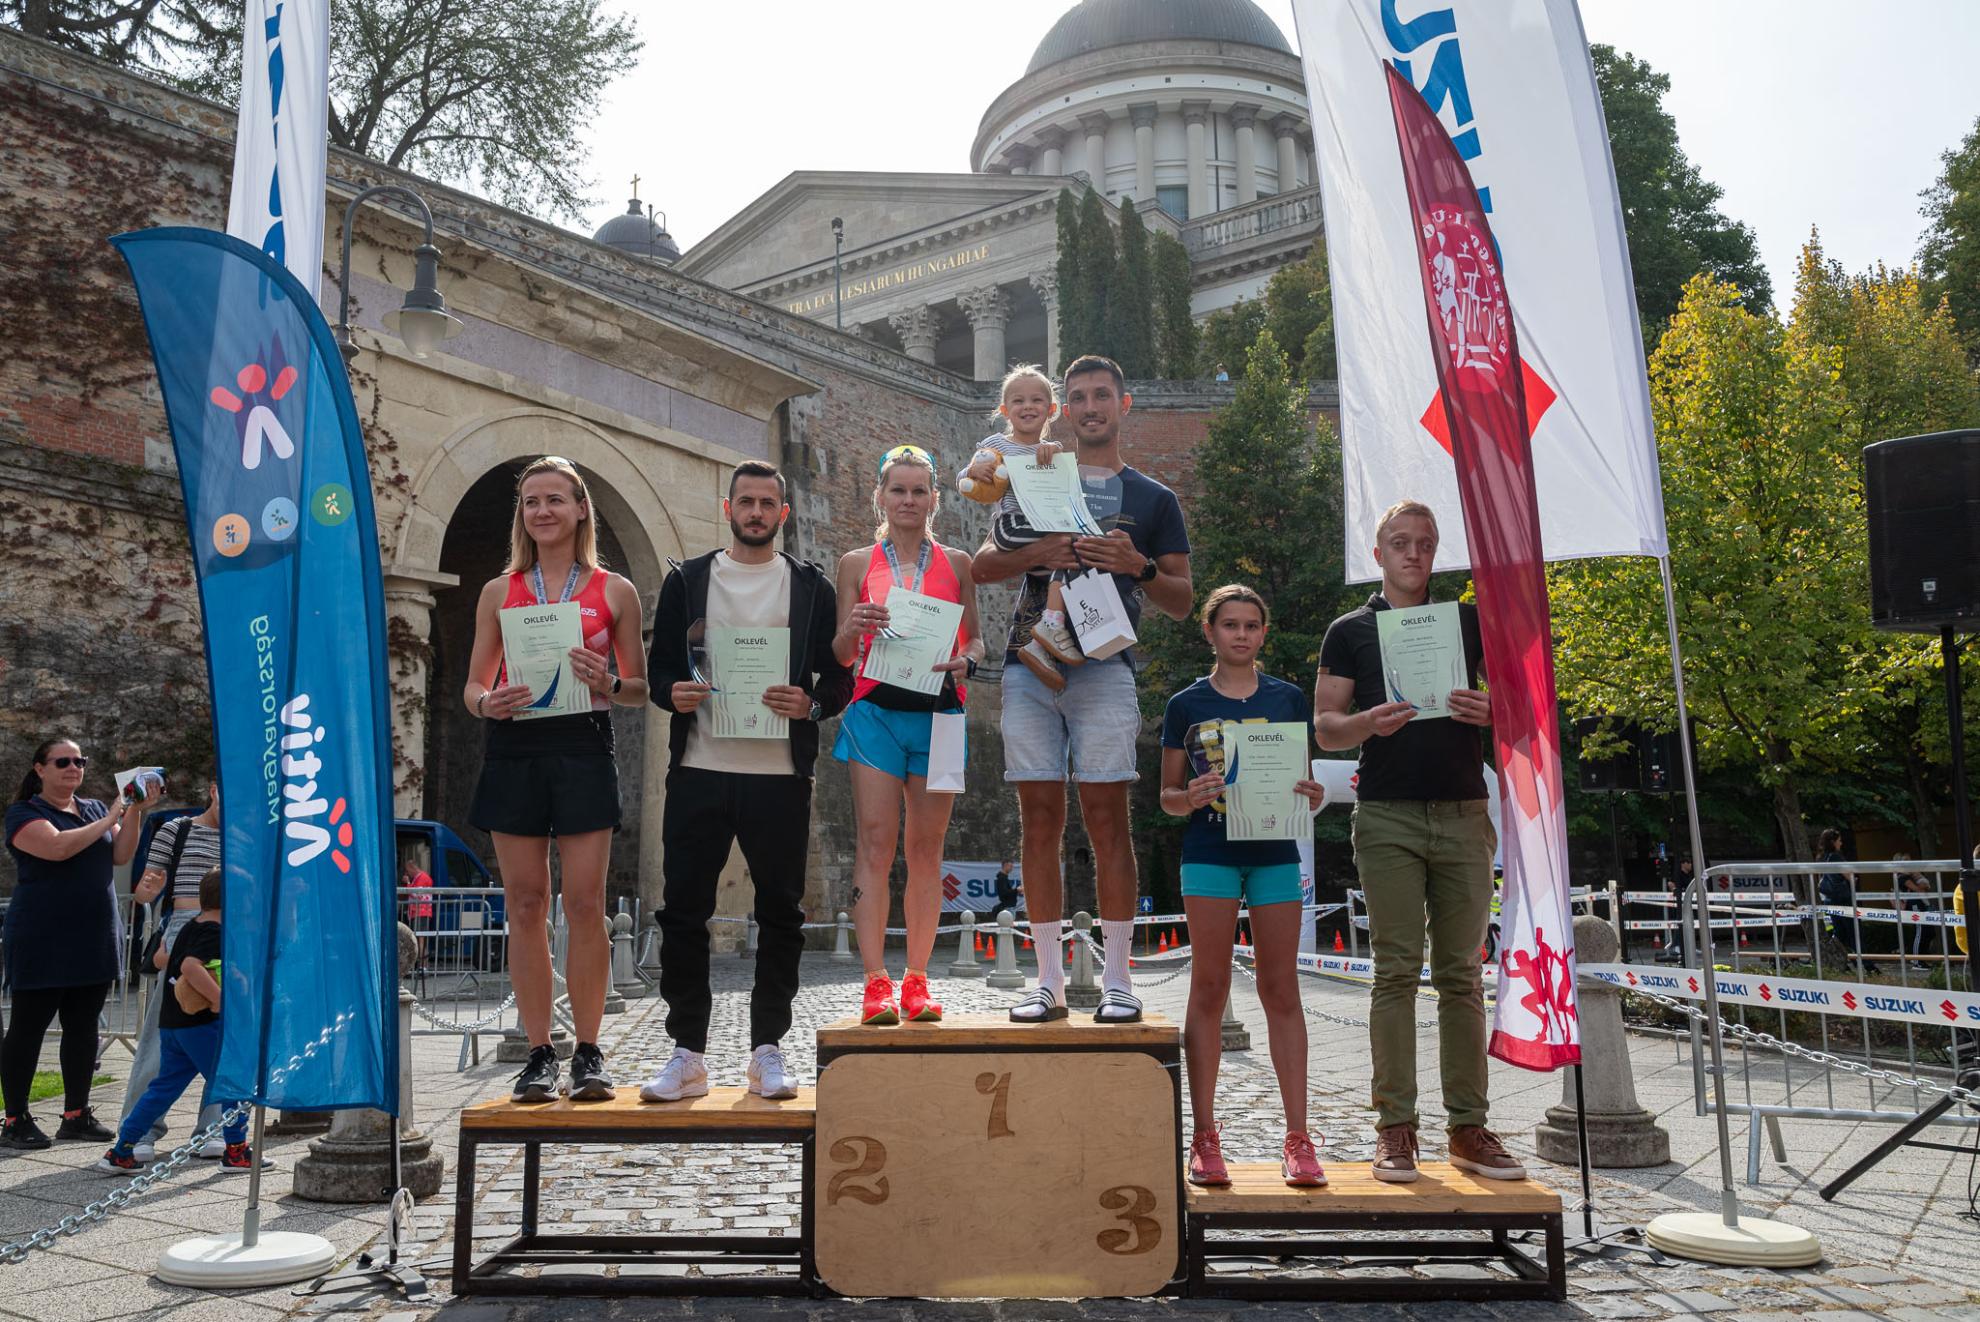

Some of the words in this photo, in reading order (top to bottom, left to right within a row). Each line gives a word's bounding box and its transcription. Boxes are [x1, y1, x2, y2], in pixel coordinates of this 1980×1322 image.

[908, 245, 990, 281] HUNGARIAE
[908, 600, 942, 614] OKLEVÉL
[523, 613, 559, 625] OKLEVÉL
[1400, 614, 1437, 626] OKLEVÉL
[734, 636, 768, 645] OKLEVÉL
[1247, 733, 1285, 742] OKLEVÉL
[1323, 960, 1341, 969] SUZUKI
[1351, 963, 1370, 973] SUZUKI
[1640, 975, 1680, 989] SUZUKI
[1777, 988, 1830, 1006] SUZUKI
[1864, 996, 1926, 1015] SUZUKI
[975, 1071, 1016, 1141] 1
[827, 1136, 890, 1206] 2
[1096, 1185, 1162, 1256] 3
